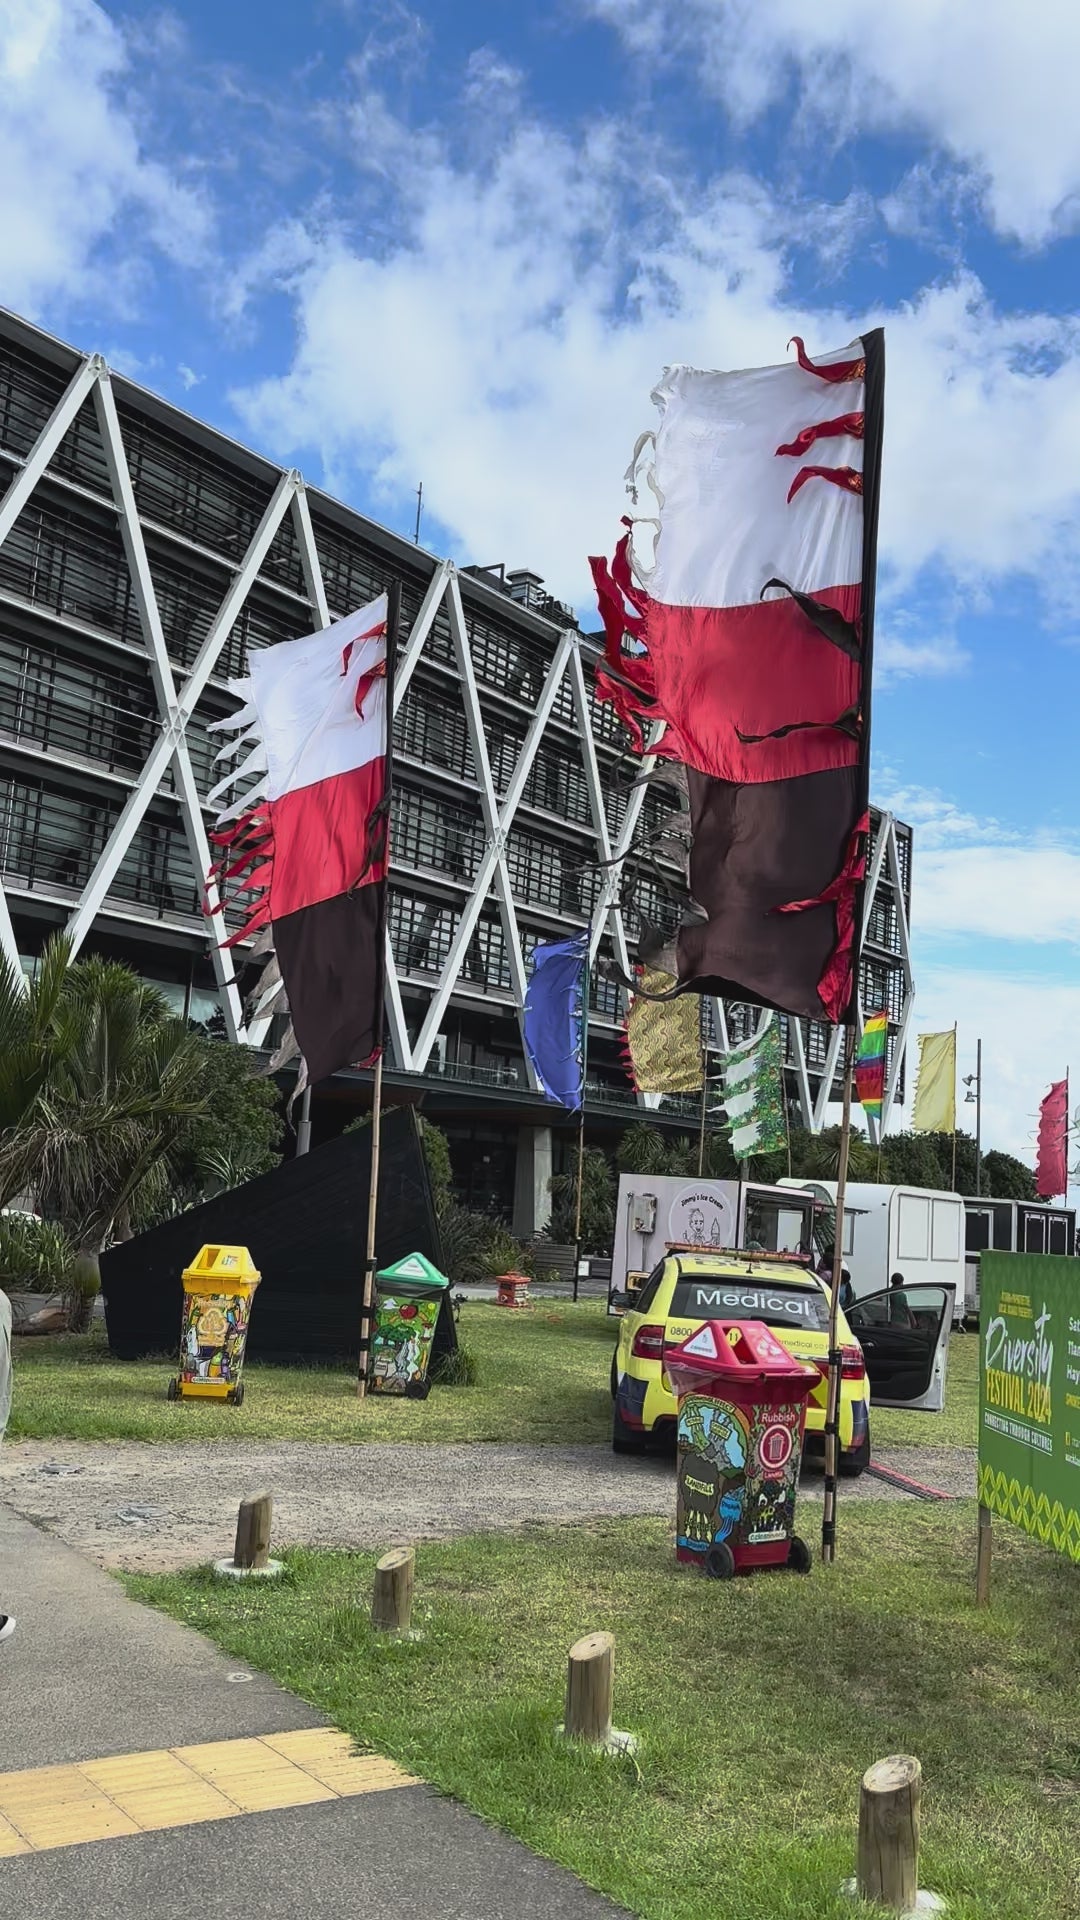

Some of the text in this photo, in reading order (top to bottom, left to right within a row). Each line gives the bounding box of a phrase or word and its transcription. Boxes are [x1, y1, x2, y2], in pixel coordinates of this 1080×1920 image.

[681, 1194, 700, 1207] Jimmy's
[708, 1197, 724, 1210] Cream
[696, 1289, 810, 1316] Medical
[670, 1326, 692, 1336] 0800
[985, 1302, 1054, 1390] Diversity
[986, 1367, 1052, 1425] FESTIVAL 2024
[761, 1412, 796, 1422] Rubbish
[984, 1411, 1009, 1433] CONNECTING
[1009, 1422, 1031, 1442] THROUGH
[1031, 1431, 1053, 1452] CULTURES
